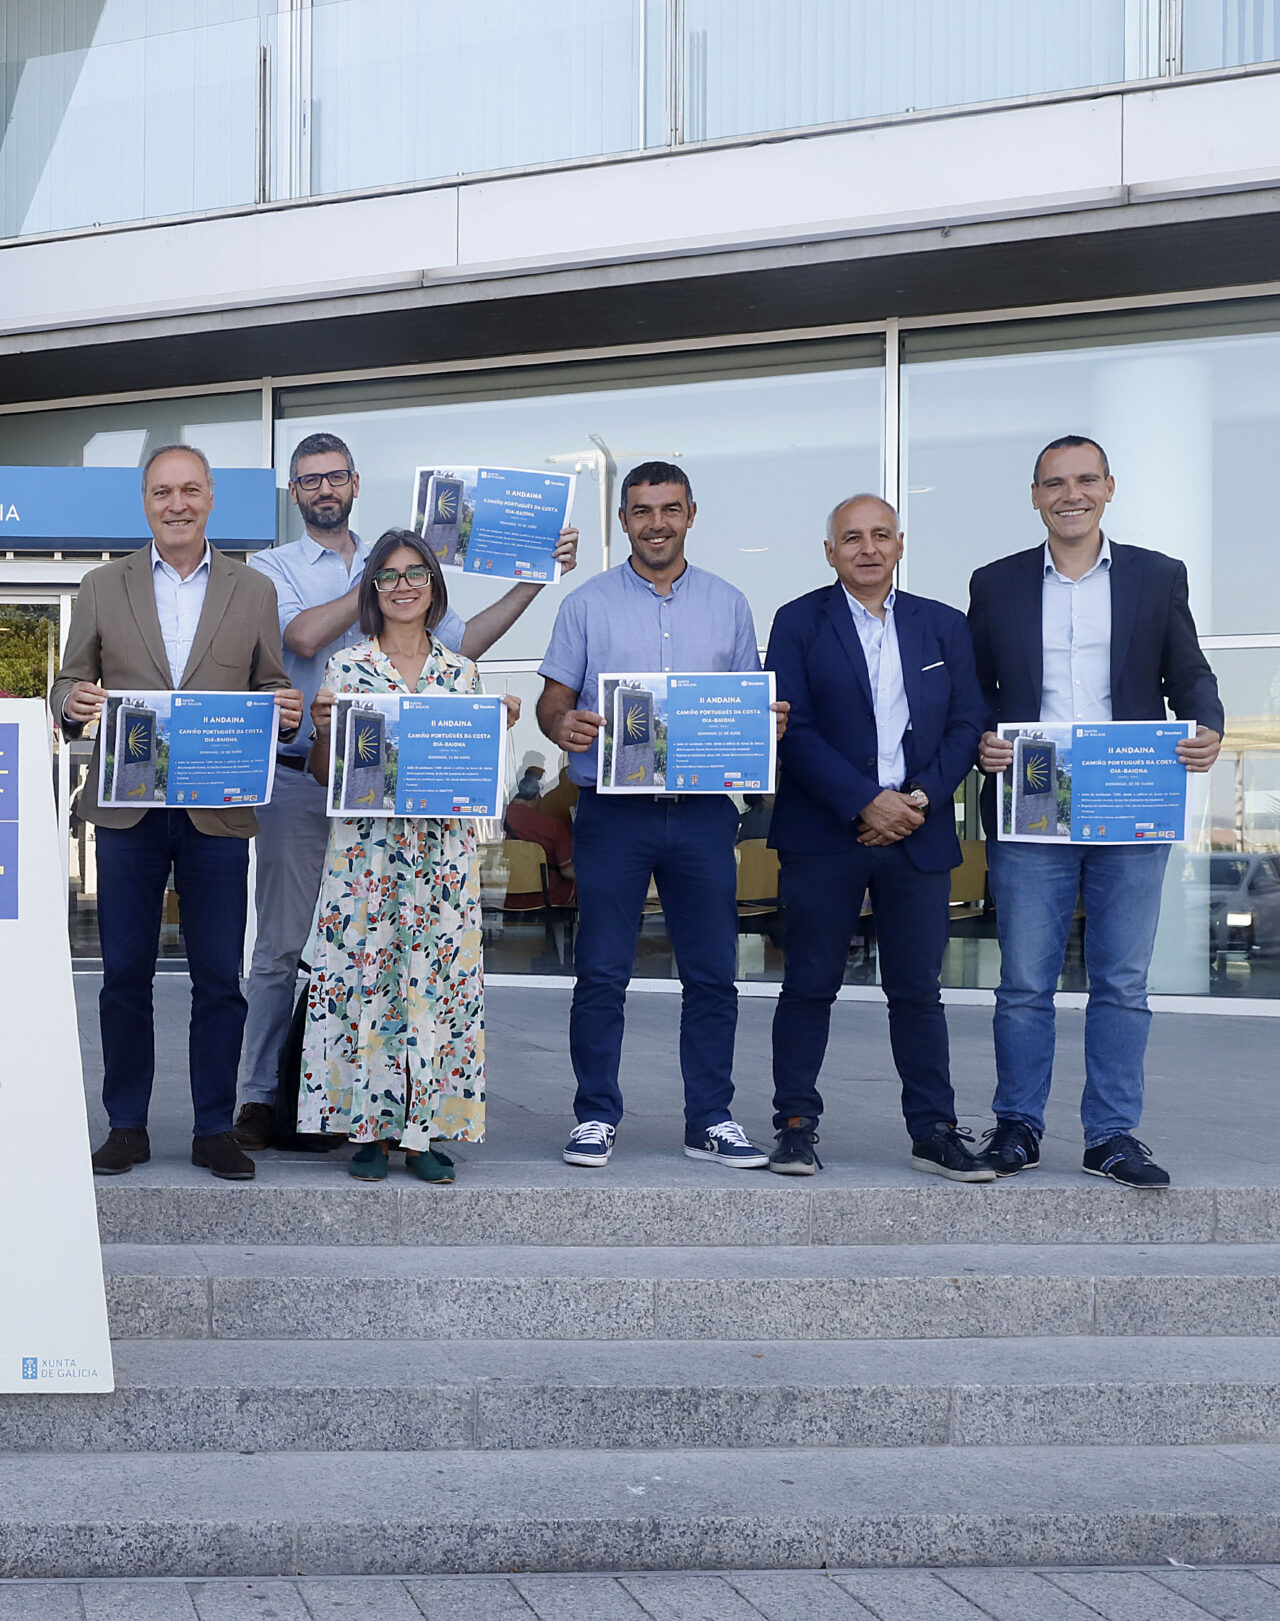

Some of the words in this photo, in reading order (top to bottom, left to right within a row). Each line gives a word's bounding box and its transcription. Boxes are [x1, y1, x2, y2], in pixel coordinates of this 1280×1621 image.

[41, 1359, 77, 1368] XUNTA
[41, 1368, 54, 1378] DE
[56, 1367, 98, 1378] GALICIA
